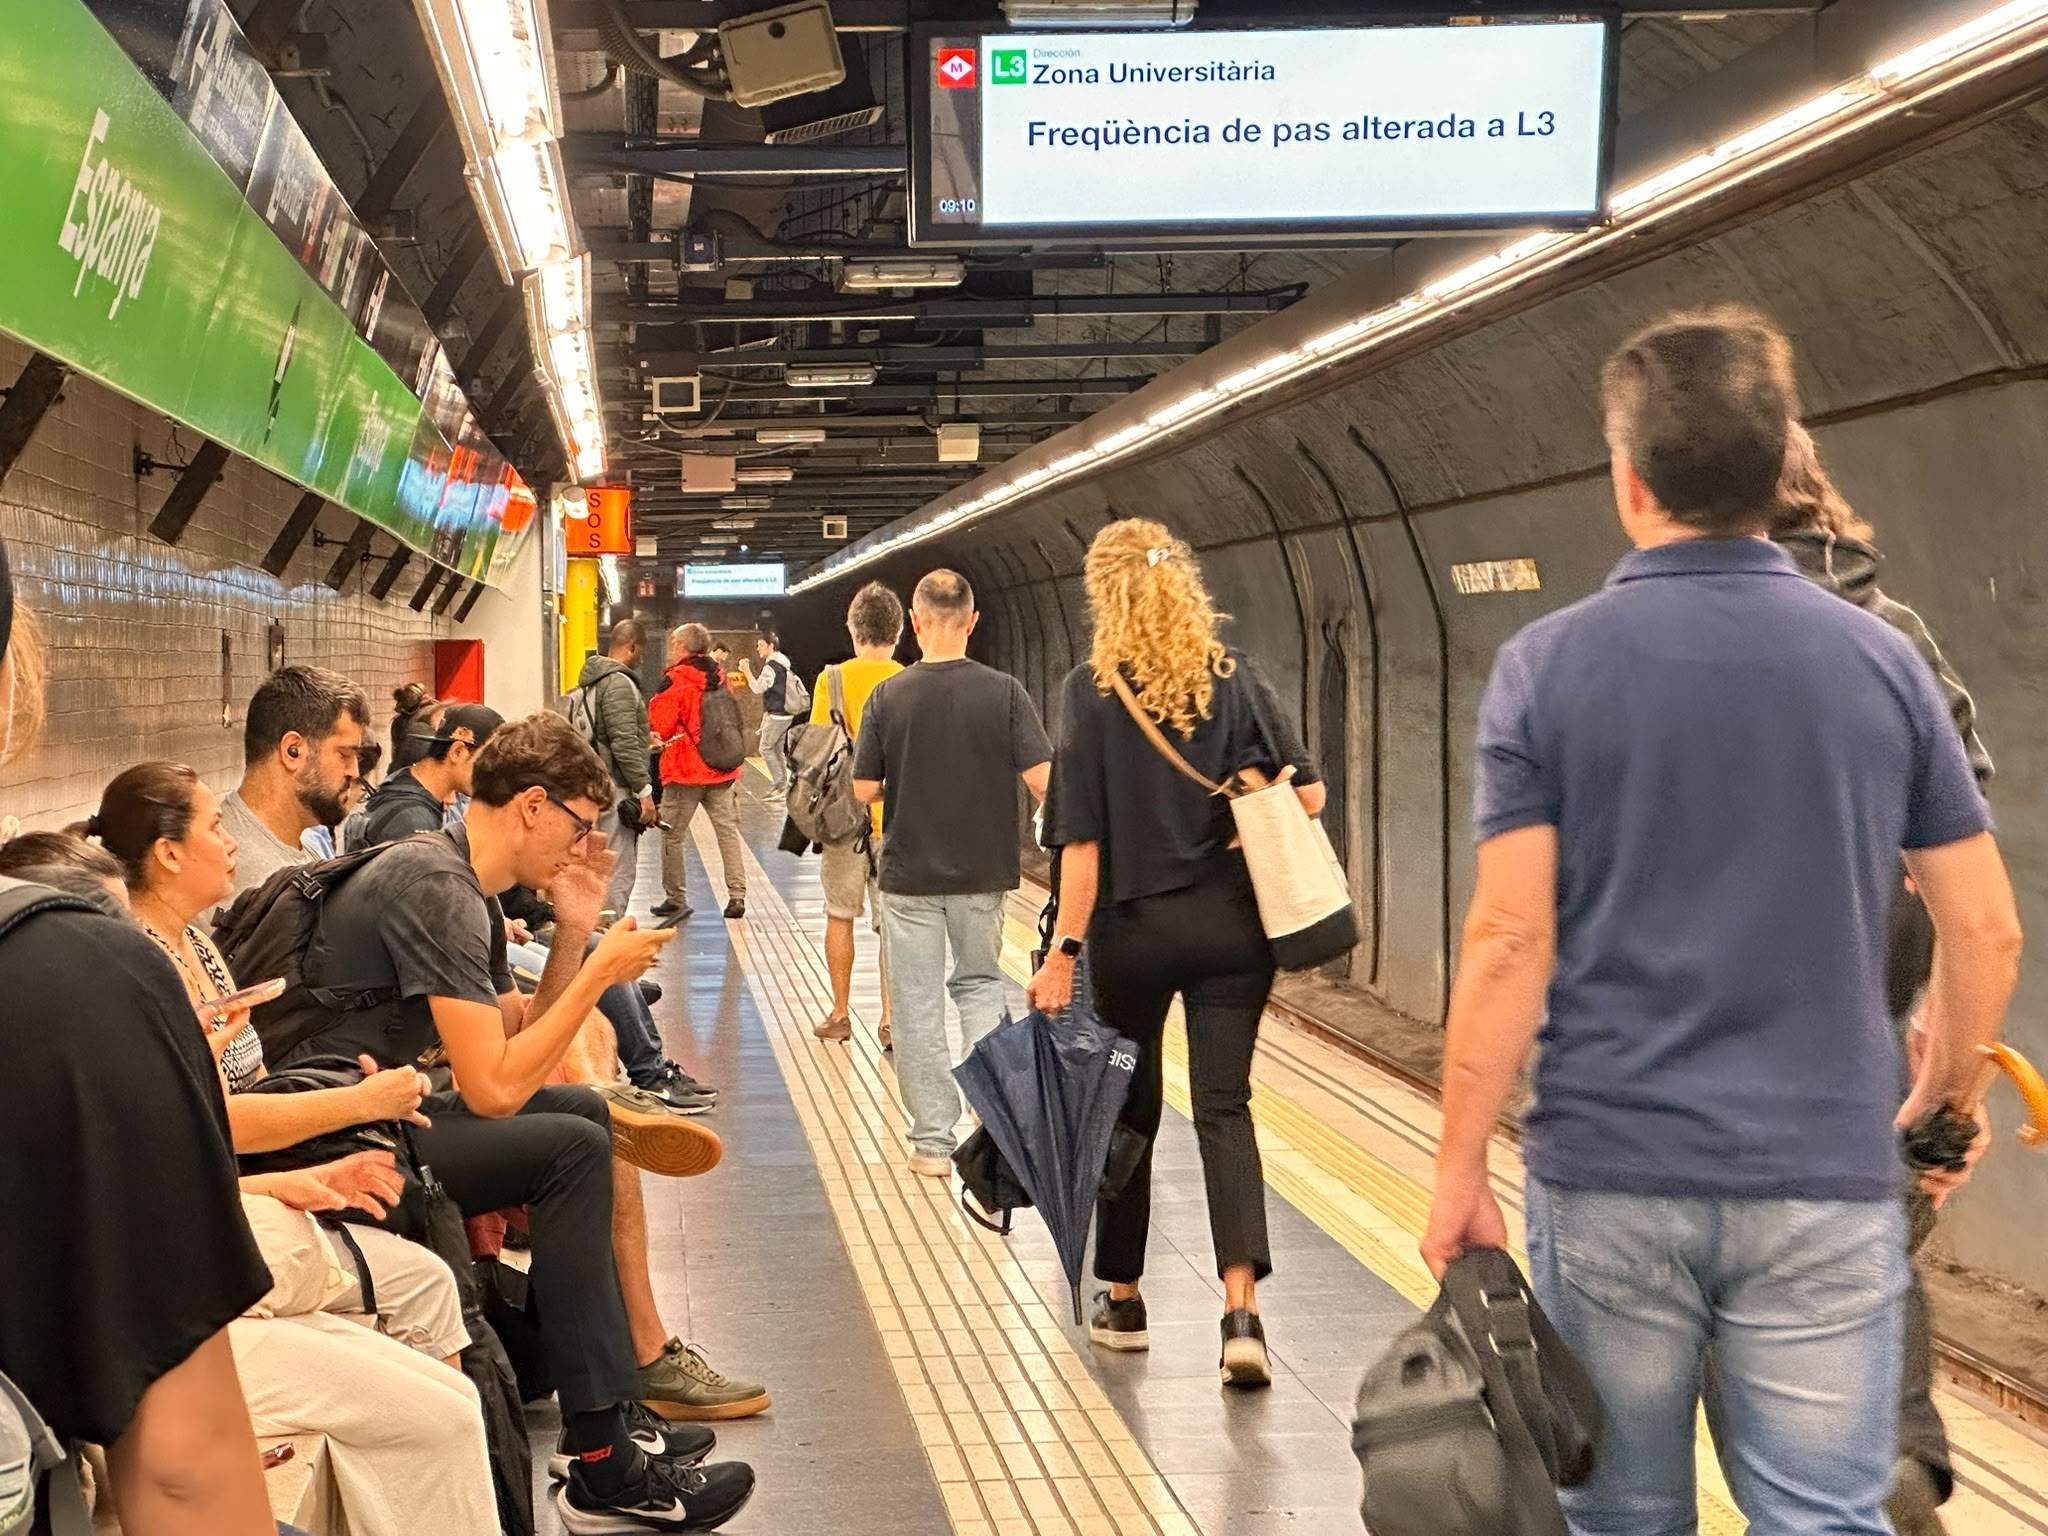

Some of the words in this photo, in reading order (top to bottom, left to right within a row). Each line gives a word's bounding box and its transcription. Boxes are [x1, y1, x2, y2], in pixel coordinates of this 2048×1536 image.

[995, 55, 1025, 77] L3
[1033, 64, 1099, 84] Zona
[1109, 60, 1276, 83] Universitària
[1028, 119, 1210, 151] Freqüència
[1222, 118, 1261, 143] de
[1273, 120, 1331, 148] pas
[1342, 113, 1475, 141] alterada
[1487, 118, 1505, 137] a
[1518, 111, 1556, 136] L3
[58, 107, 160, 320] Espanya
[940, 199, 976, 212] 09:10
